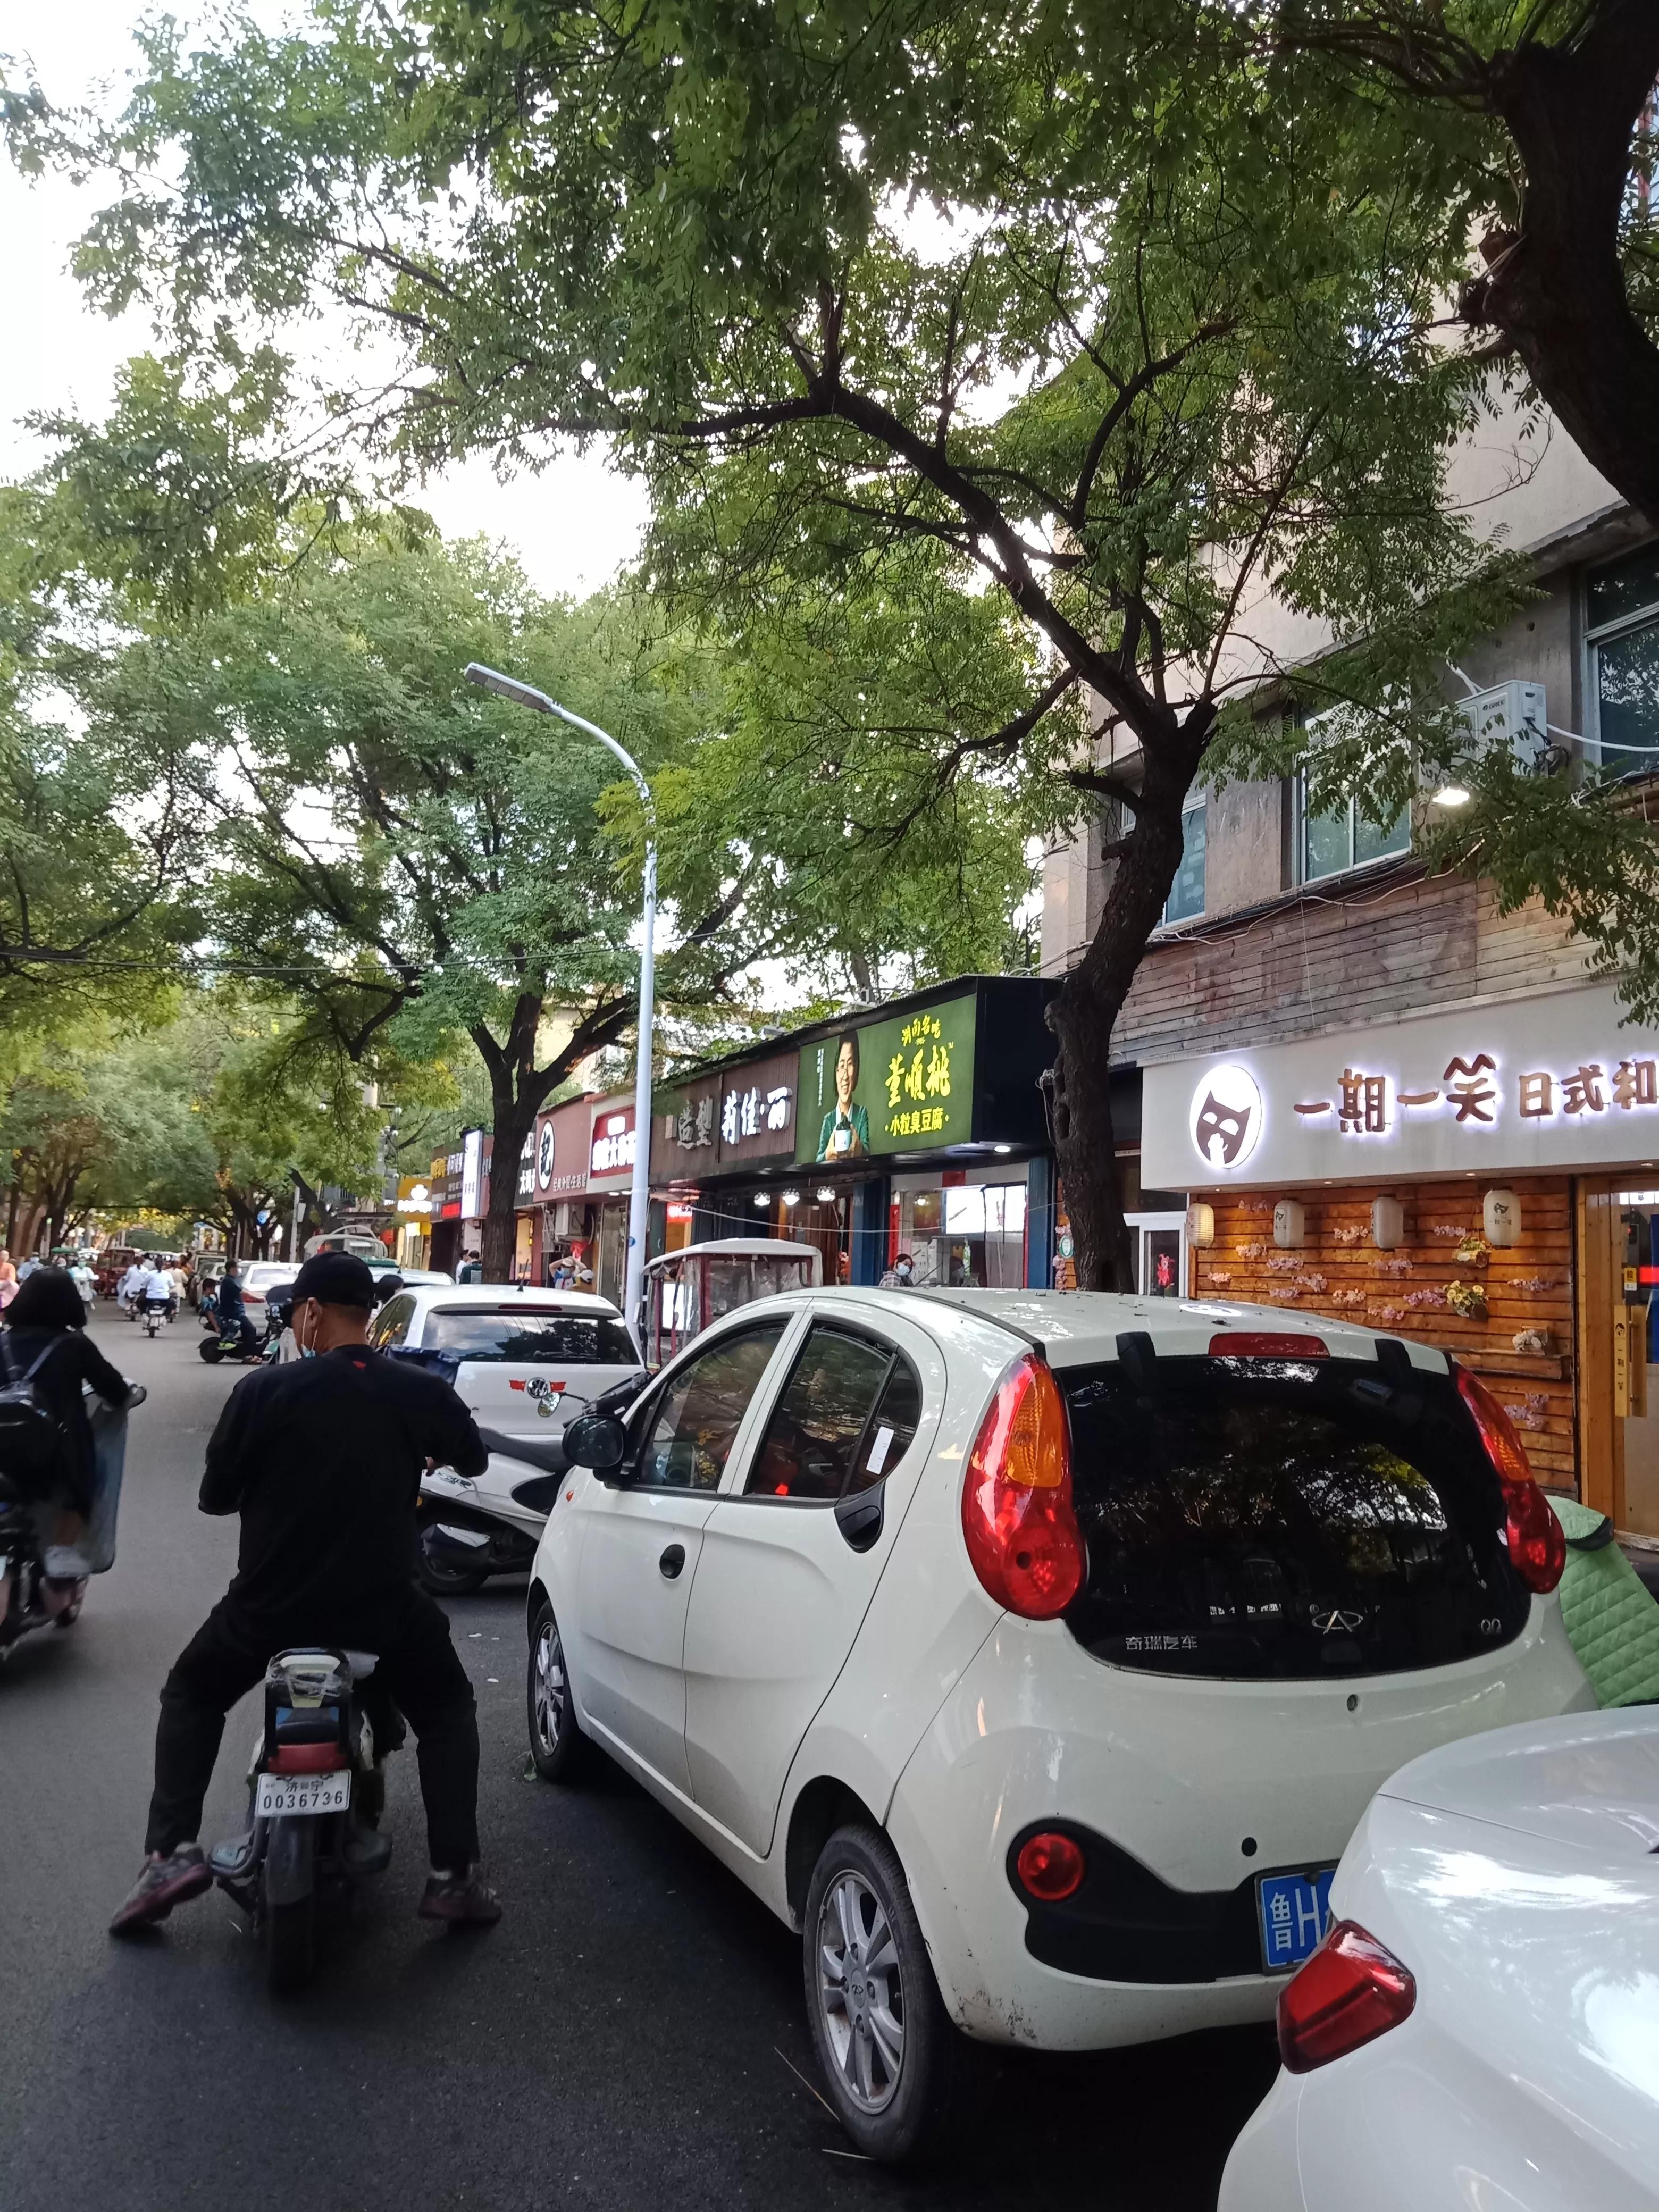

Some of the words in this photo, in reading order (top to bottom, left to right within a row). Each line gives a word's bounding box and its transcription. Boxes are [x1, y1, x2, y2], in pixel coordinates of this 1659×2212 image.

[1293, 1053, 1496, 1133] 一期一笑
[890, 1107, 944, 1137] 小粒臭豆腐
[1125, 1635, 1198, 1650] 奇瑞汽车
[263, 1790, 343, 1809] 0036736
[1270, 1886, 1331, 1951] 鲁H
